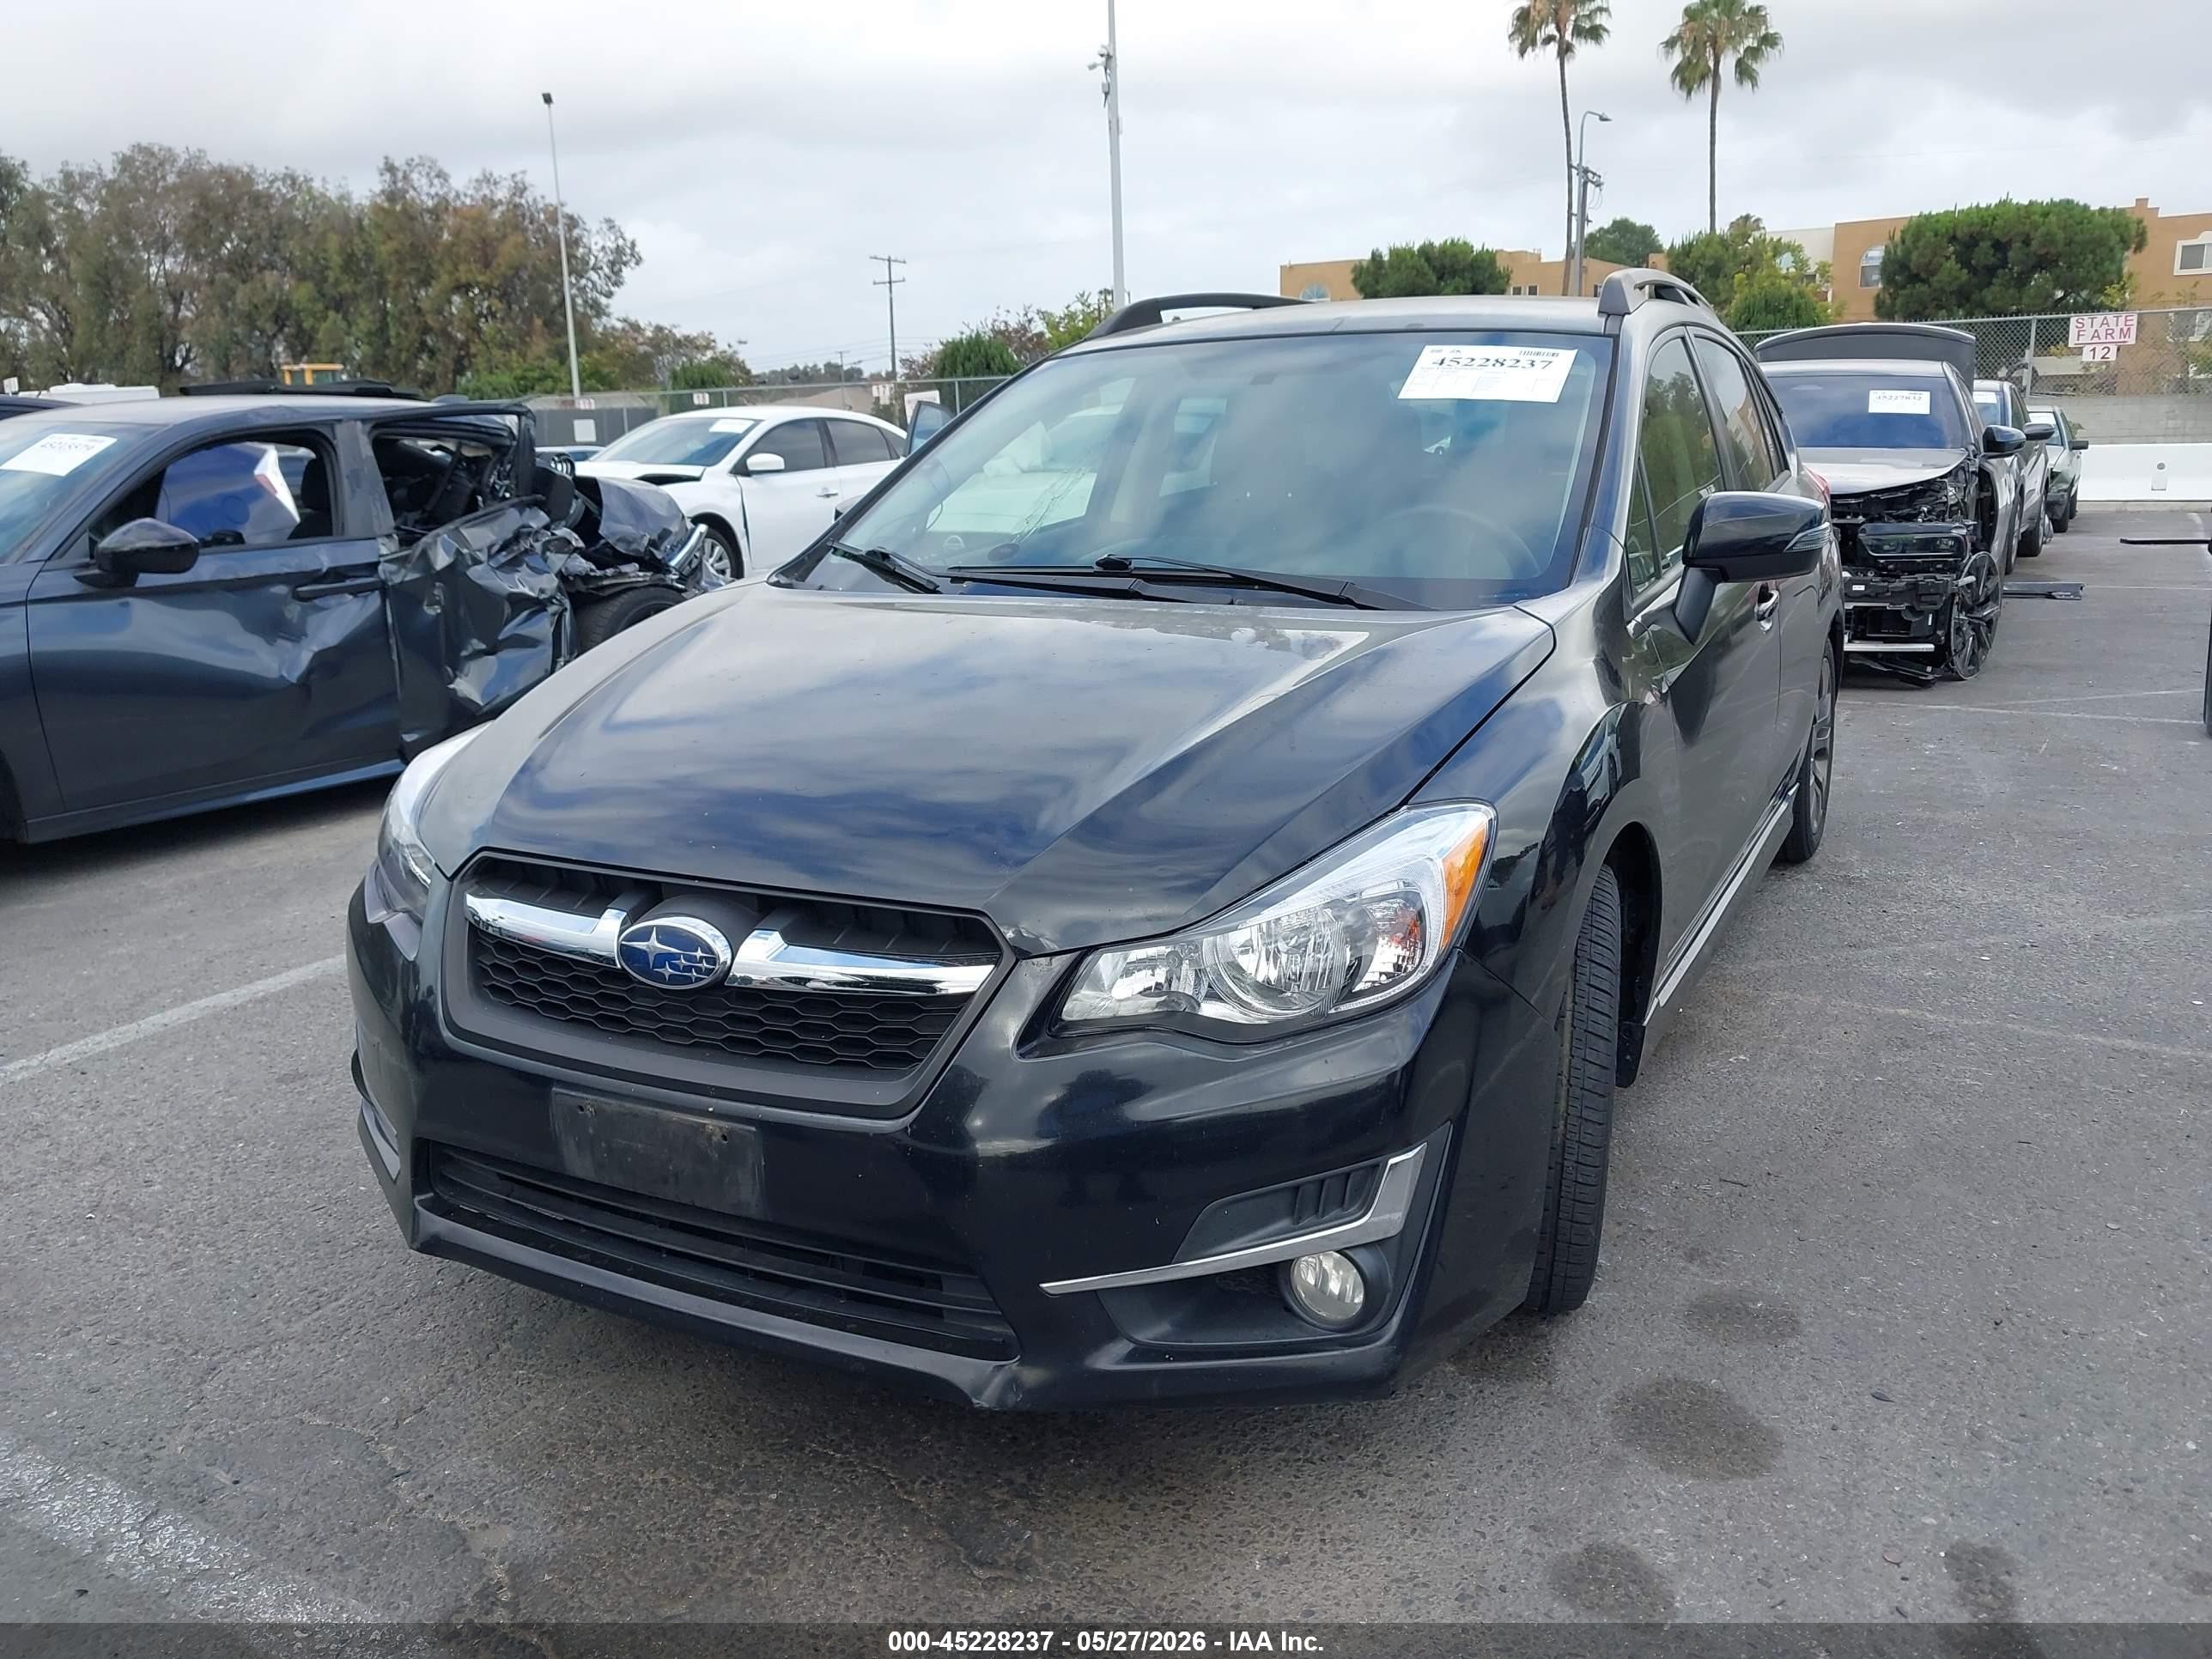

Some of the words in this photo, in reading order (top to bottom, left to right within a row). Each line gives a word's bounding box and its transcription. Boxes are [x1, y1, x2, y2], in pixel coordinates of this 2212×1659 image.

[2075, 314, 2135, 329] STATE
[2076, 327, 2131, 341] FARM
[2089, 346, 2111, 360] 12
[1431, 356, 1553, 370] 45228237
